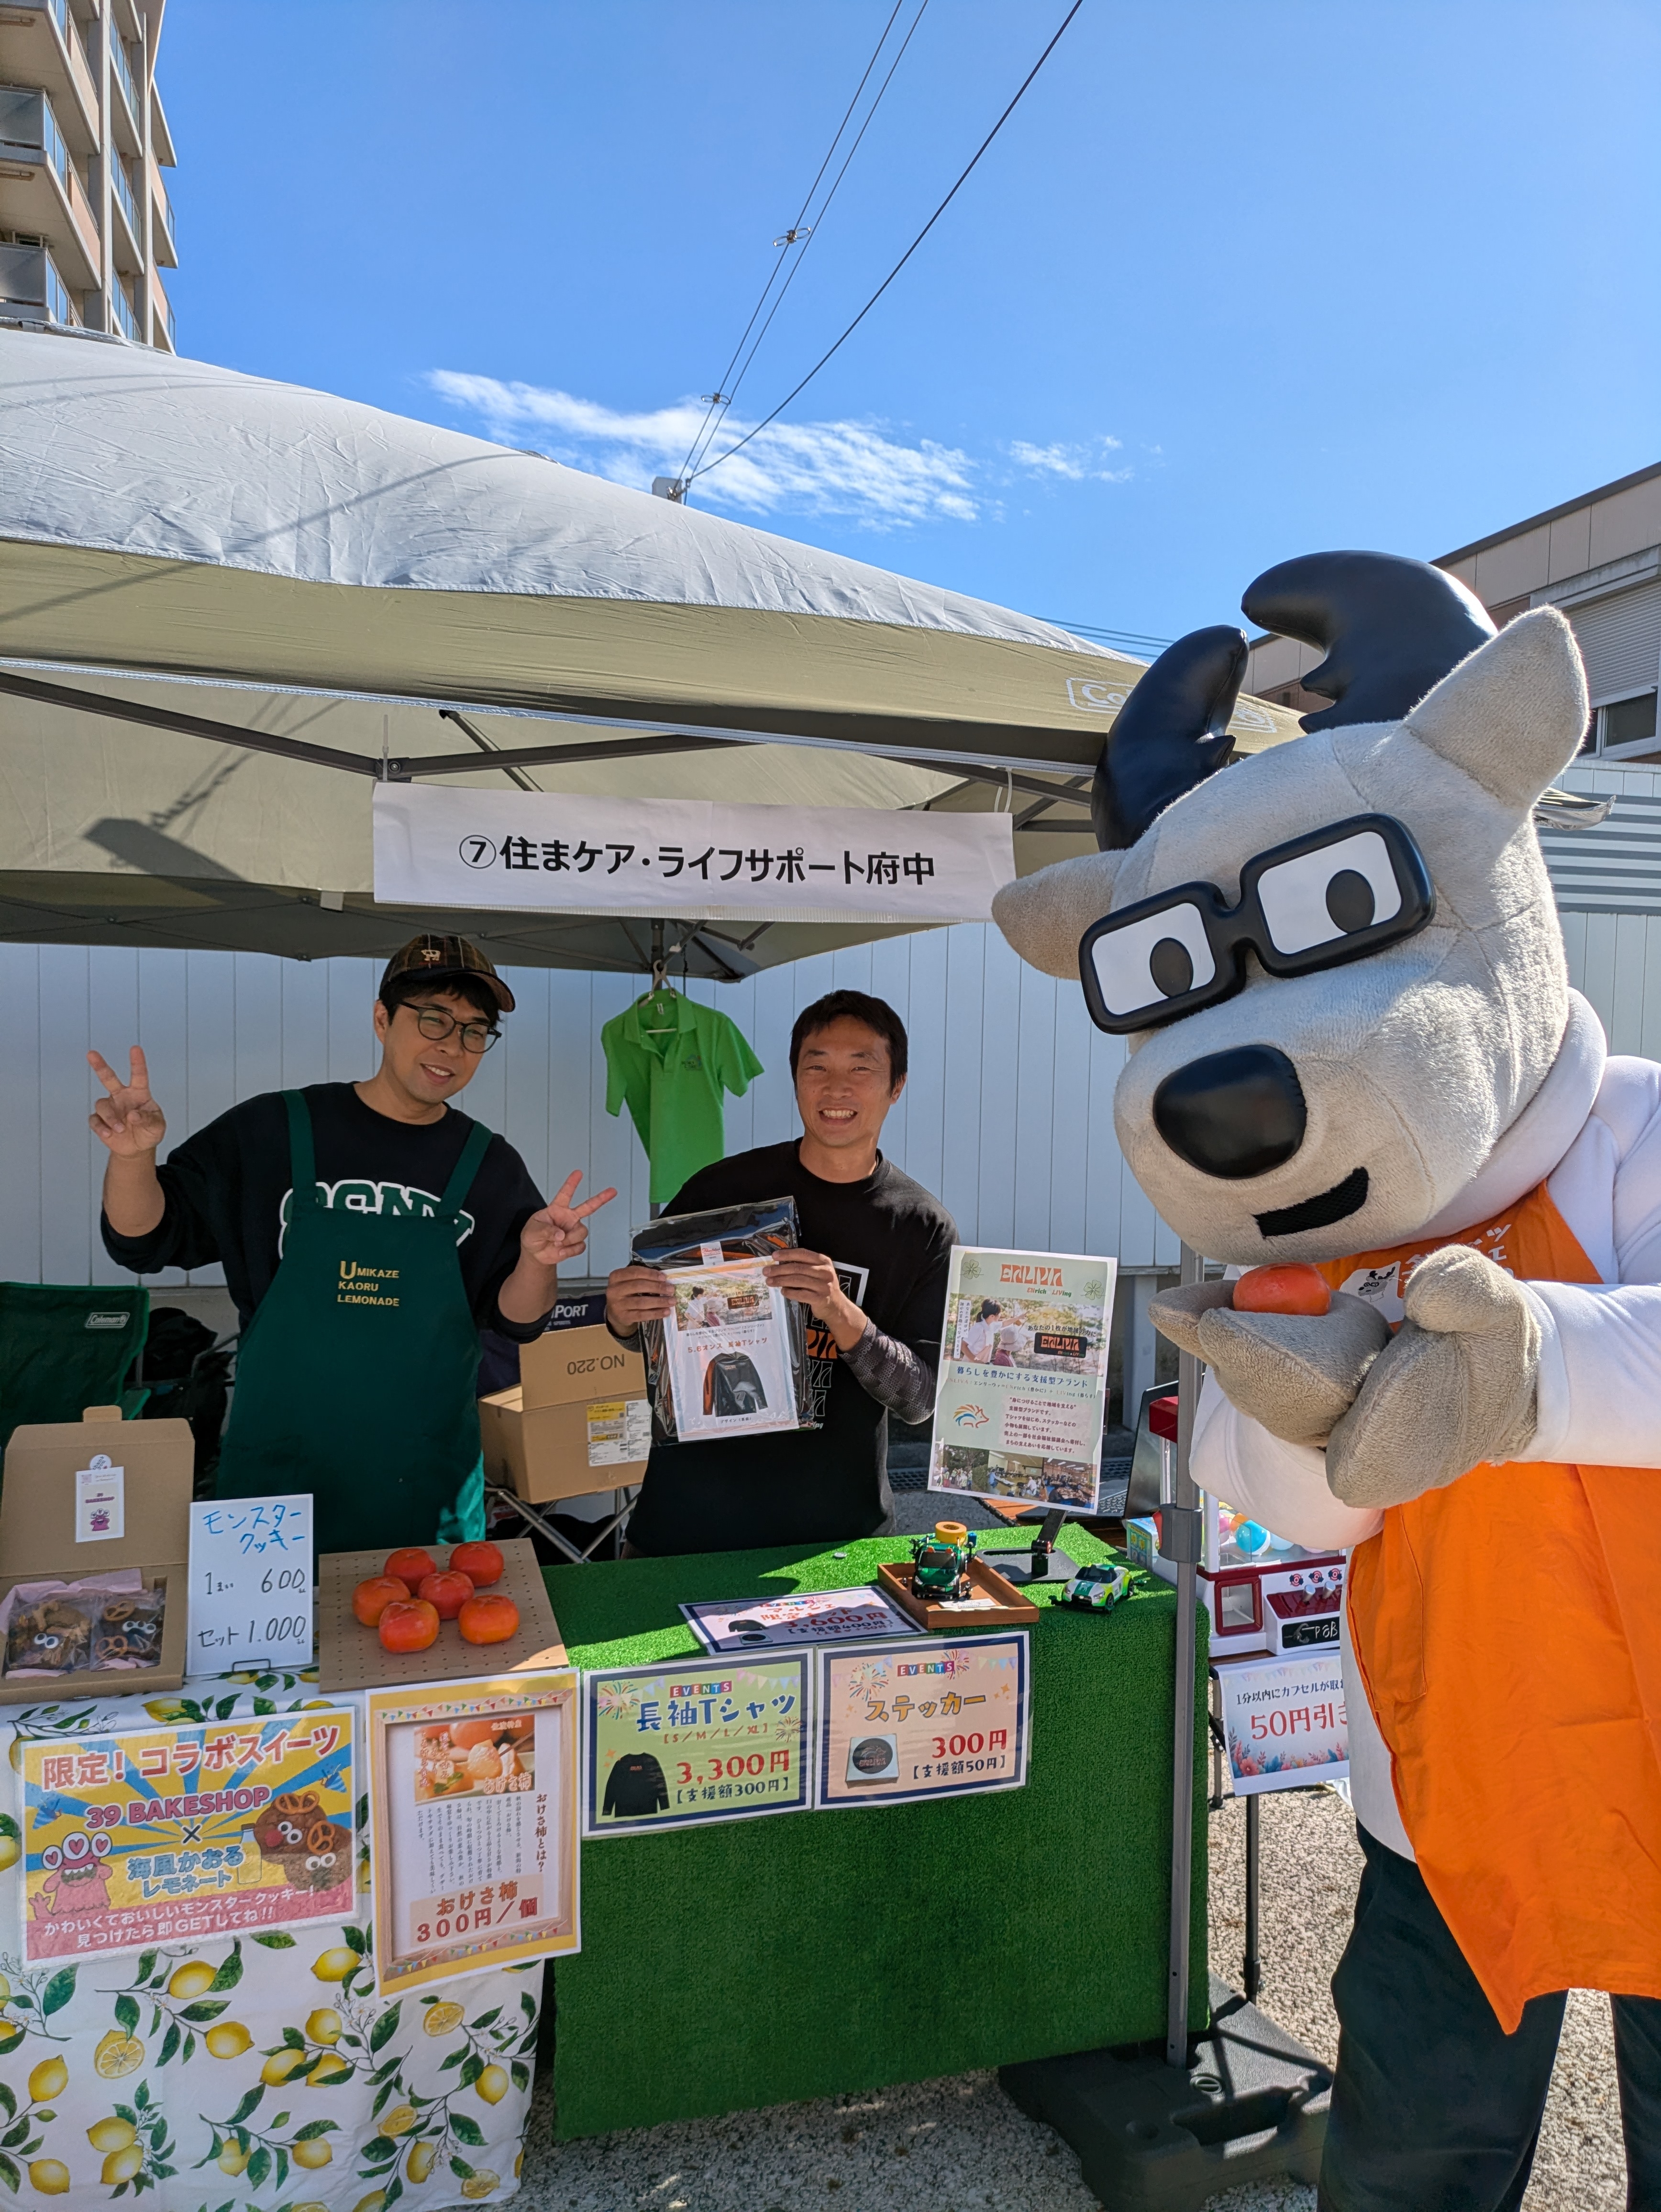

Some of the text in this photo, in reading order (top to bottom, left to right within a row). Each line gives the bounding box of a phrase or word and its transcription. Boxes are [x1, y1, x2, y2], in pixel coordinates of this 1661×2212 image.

[340, 1260, 399, 1279] UMIKAZE
[338, 1281, 378, 1292] KAORU
[1052, 1289, 1072, 1298] LIVing
[337, 1294, 399, 1306] LEMONADE
[1028, 1325, 1096, 1337] あなたの1枚が地域の力に
[687, 1343, 722, 1353] 5.6オンス
[567, 1354, 625, 1375] NO.220
[957, 1366, 1087, 1387] 暮らしを豊かにする支援型ブランド
[1009, 1405, 1052, 1416] 支援型ブランドです。
[202, 1504, 301, 1534] モンスター
[240, 1529, 305, 1554] クッキー
[761, 1609, 852, 1620] 限定セット
[785, 1612, 887, 1627] 3,600円
[197, 1626, 239, 1647] セット
[901, 1662, 952, 1675] EVENTS
[672, 1682, 730, 1696] EVENTS
[637, 1695, 795, 1733] 長袖Tシャツ
[865, 1691, 986, 1722] ステッカー
[932, 1729, 1007, 1758] 300円
[676, 1749, 789, 1784] 3,300円
[87, 1787, 270, 1827] 39 BAKESHOP
[127, 1845, 244, 1880] 海風かおる
[436, 1880, 518, 1916] おけさ柿
